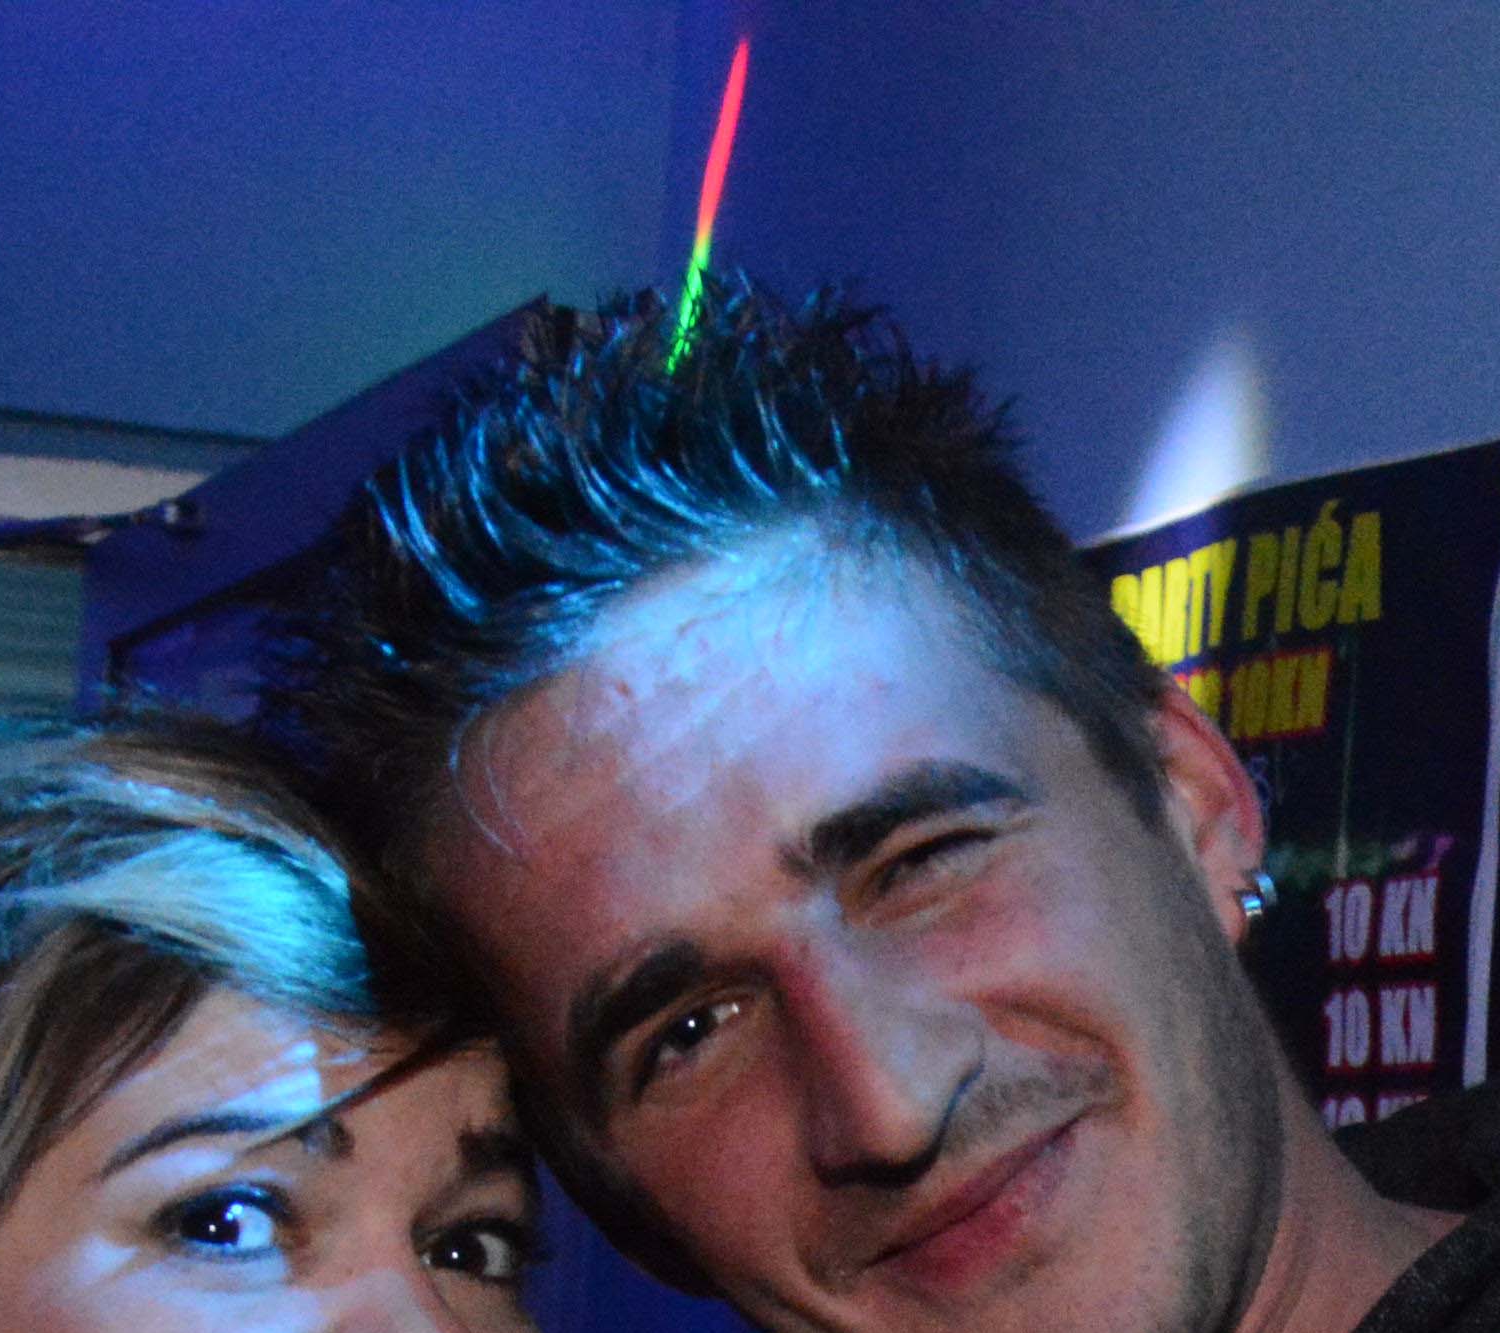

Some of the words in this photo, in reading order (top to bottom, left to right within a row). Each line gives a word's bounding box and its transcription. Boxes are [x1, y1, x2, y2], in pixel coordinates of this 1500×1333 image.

[1241, 500, 1382, 640] PIĆA
[1324, 882, 1372, 961] 10
[1379, 876, 1438, 957] KN
[1324, 988, 1370, 1067] 10
[1380, 985, 1436, 1064] KN
